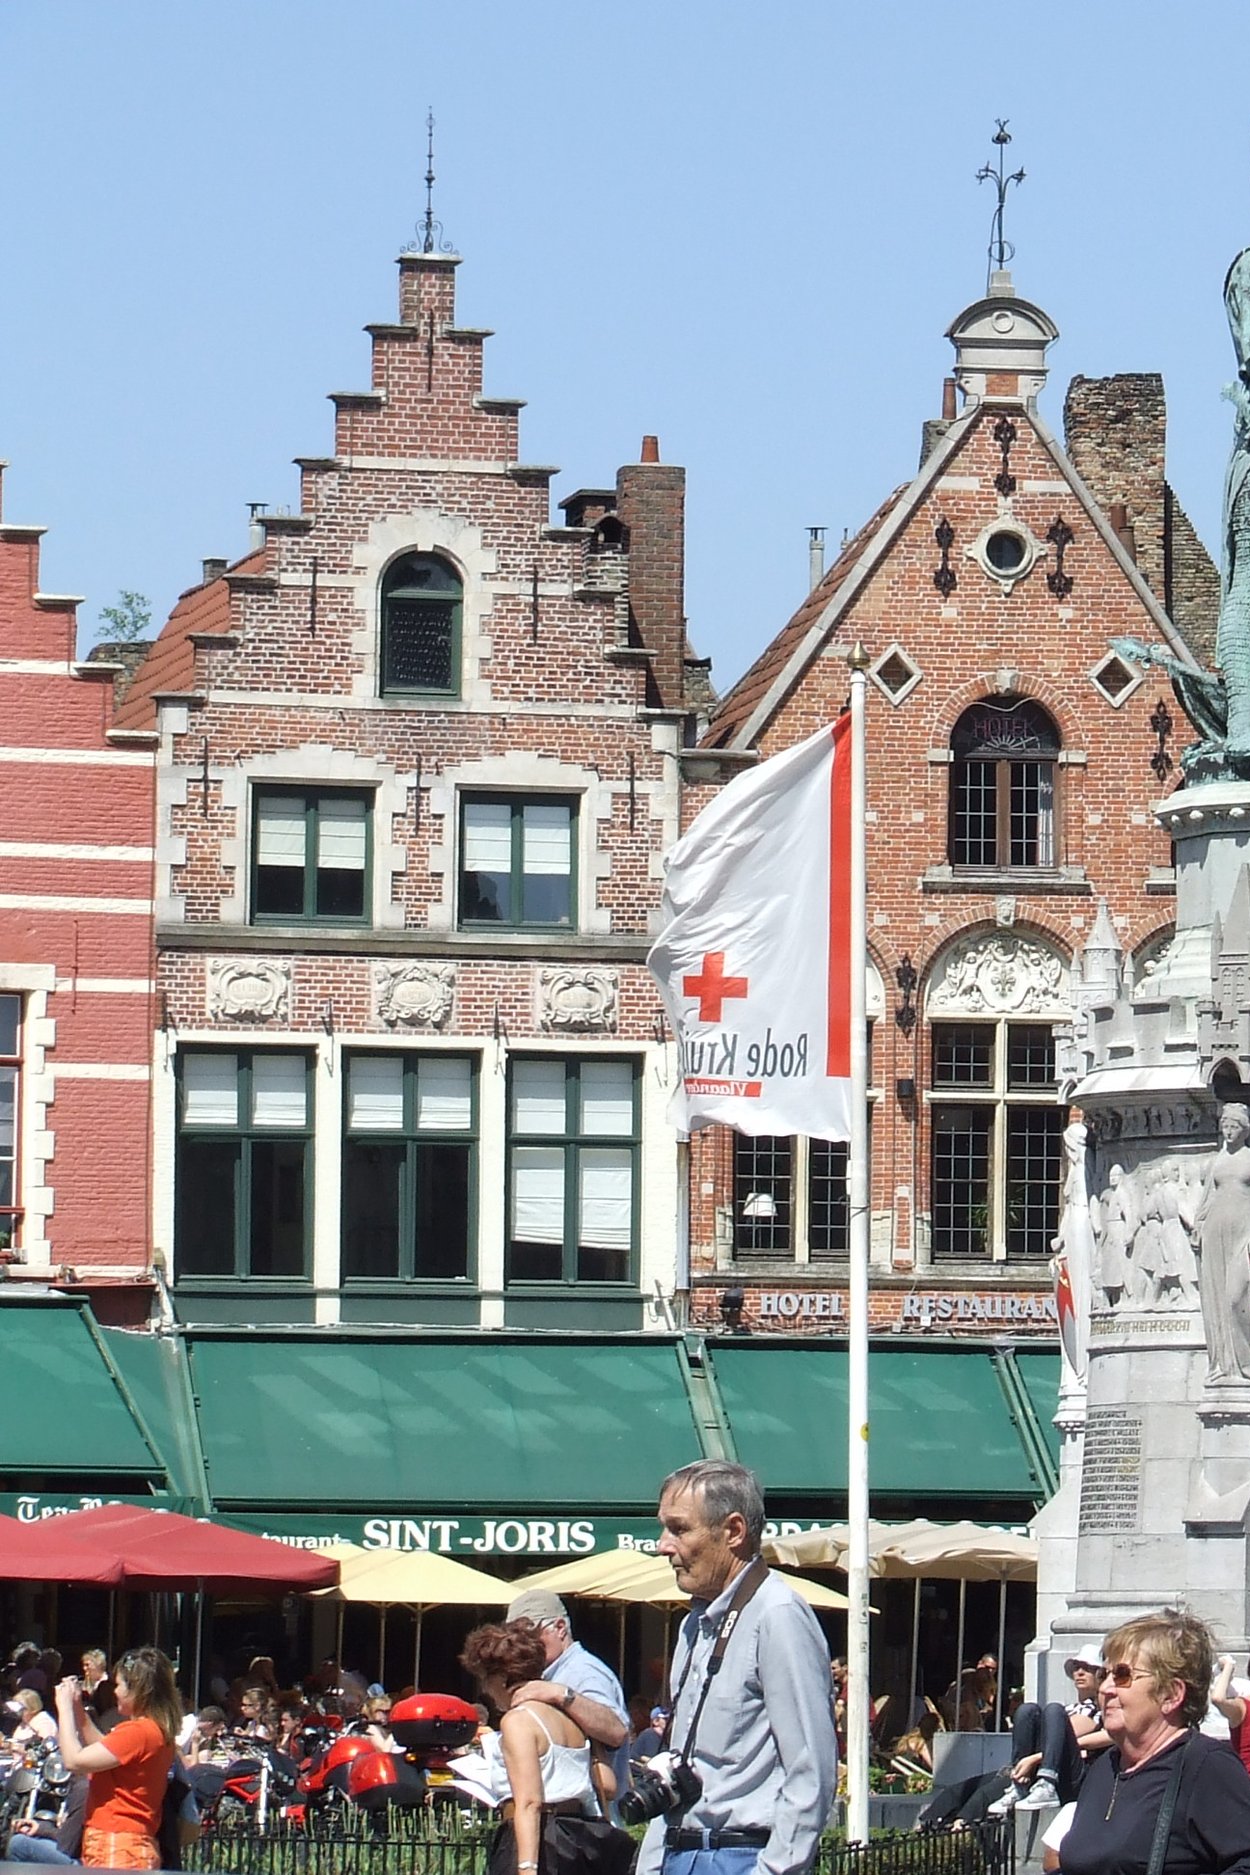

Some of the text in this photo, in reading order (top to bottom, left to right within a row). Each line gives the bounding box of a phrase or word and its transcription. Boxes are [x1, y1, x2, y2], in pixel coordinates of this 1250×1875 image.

[760, 1293, 1057, 1319] HOTEL RESTAURAN
[362, 1519, 596, 1551] SINT-JORIS
